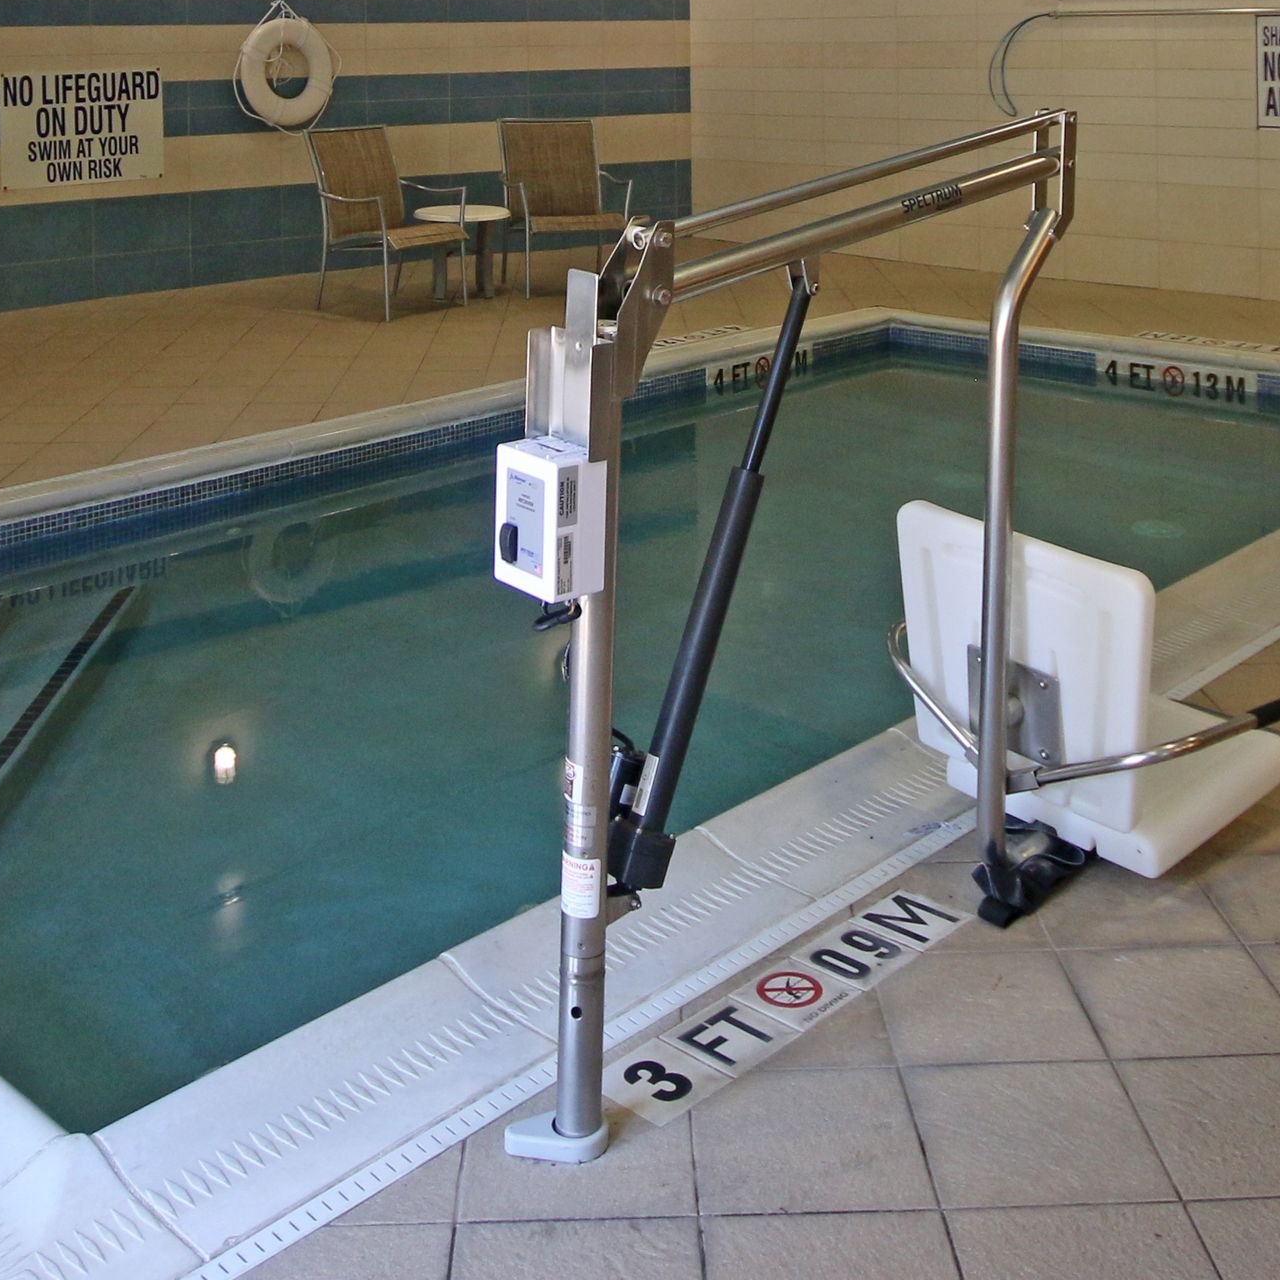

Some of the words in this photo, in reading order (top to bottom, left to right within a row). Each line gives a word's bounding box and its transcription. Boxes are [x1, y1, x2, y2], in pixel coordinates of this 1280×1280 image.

[3, 75, 33, 107] NO
[42, 71, 160, 105] LIFEGUARD
[36, 107, 65, 138] ON
[75, 104, 130, 135] DUTY
[28, 139, 71, 162] SWIM
[77, 138, 94, 158] AT
[99, 135, 139, 156] YOUR
[47, 161, 83, 183] OWN
[88, 157, 122, 179] RISK
[900, 184, 963, 213] SPECTRUM
[803, 1011, 819, 1023] NO
[817, 991, 849, 1012] DIVING
[623, 1060, 693, 1102] 3
[678, 1007, 774, 1067] FT
